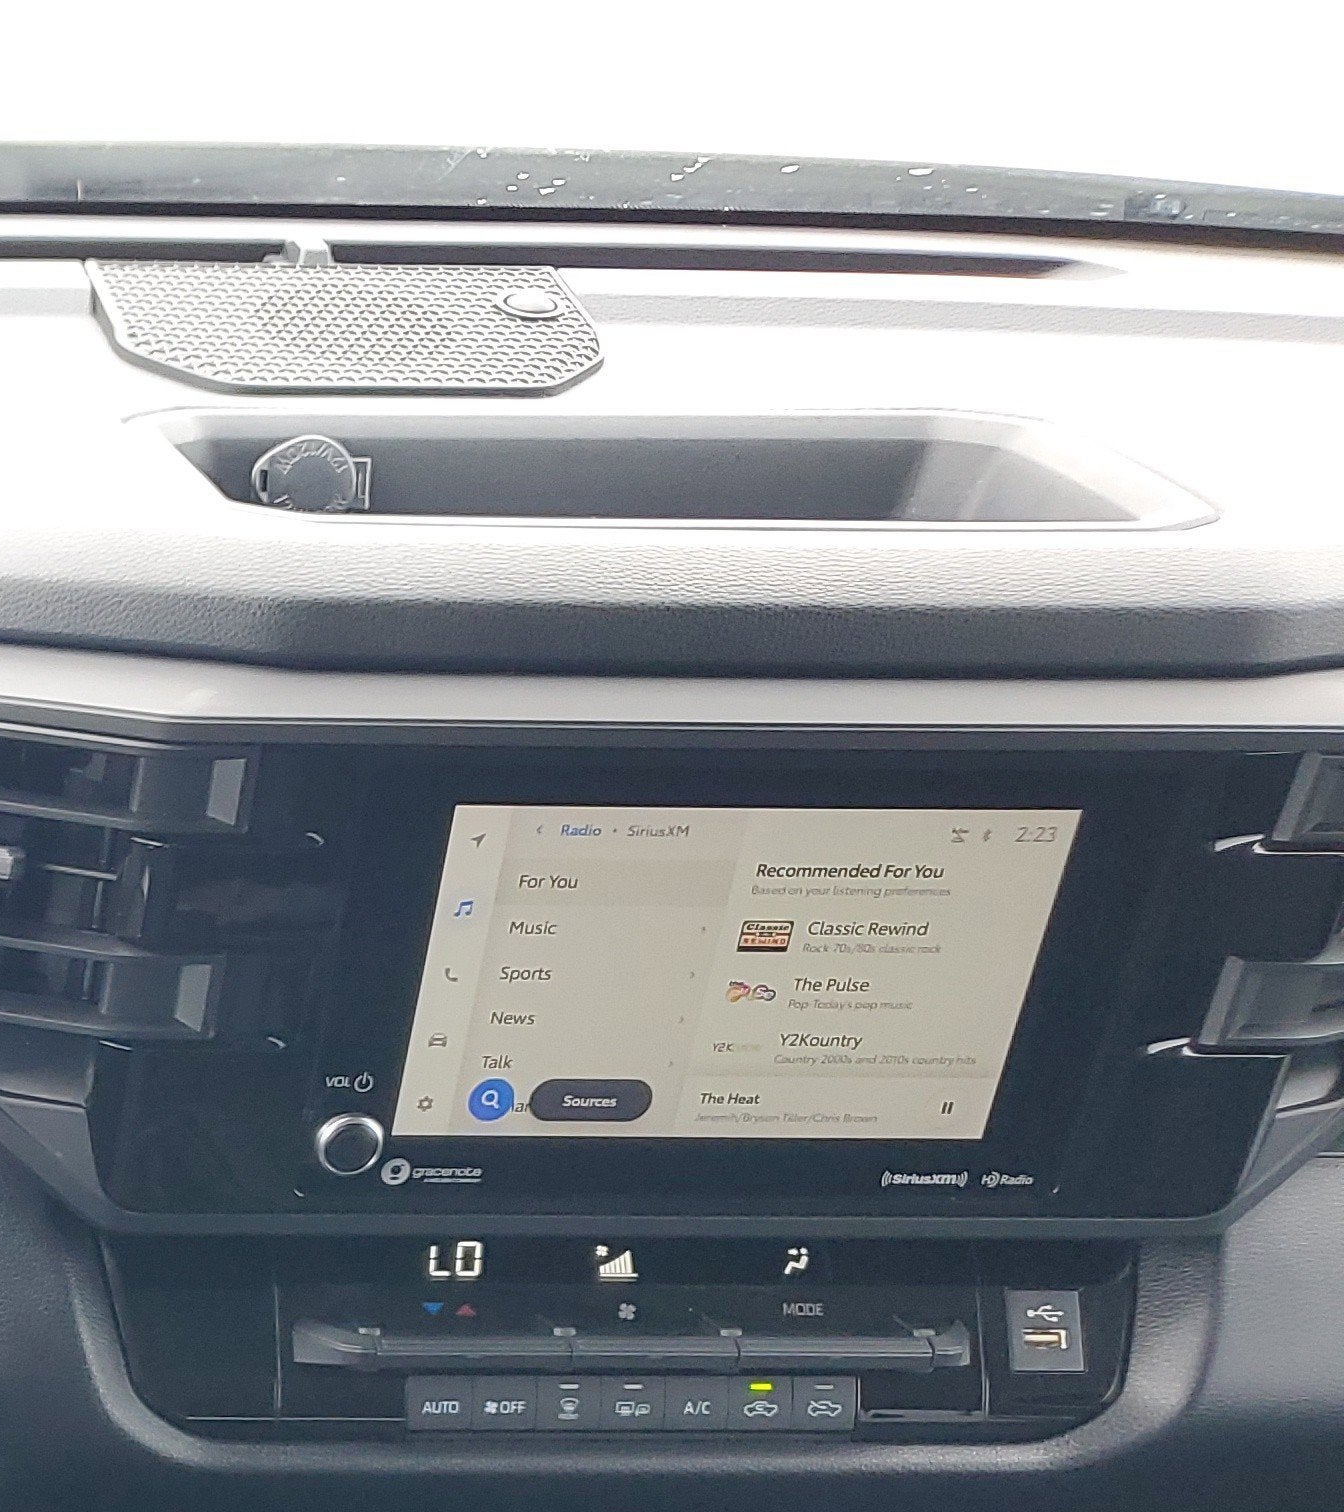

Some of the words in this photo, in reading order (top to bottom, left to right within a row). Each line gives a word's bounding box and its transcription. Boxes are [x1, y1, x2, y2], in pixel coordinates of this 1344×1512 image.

[560, 824, 602, 838] Radio
[626, 823, 690, 838] SiriusXM
[1014, 826, 1058, 843] 2:23
[755, 863, 881, 880] Recommended
[883, 863, 912, 879] For
[913, 863, 945, 880] You
[518, 874, 545, 890] For
[548, 874, 579, 890] You
[751, 886, 786, 897] Based
[805, 887, 831, 899] your
[832, 886, 882, 899] listening
[884, 886, 952, 899] preferences
[508, 920, 558, 936] Music
[807, 921, 864, 936] Classic
[867, 921, 930, 937] Rewind
[499, 965, 552, 983] Sports
[793, 978, 823, 992] The
[826, 978, 871, 992] Pulse
[490, 1010, 535, 1026] News
[779, 1033, 863, 1050] Y2Kountry
[481, 1054, 512, 1070] Talk
[325, 1075, 351, 1089] VOL
[562, 1094, 618, 1108] Sources
[699, 1092, 724, 1105] The
[727, 1092, 761, 1105] Heat
[1000, 1173, 1034, 1186] Radio
[429, 1241, 484, 1278] LO
[782, 1302, 824, 1317] MODE
[421, 1400, 460, 1416] AUTO
[499, 1400, 527, 1416] OFF
[683, 1400, 712, 1416] A/C
